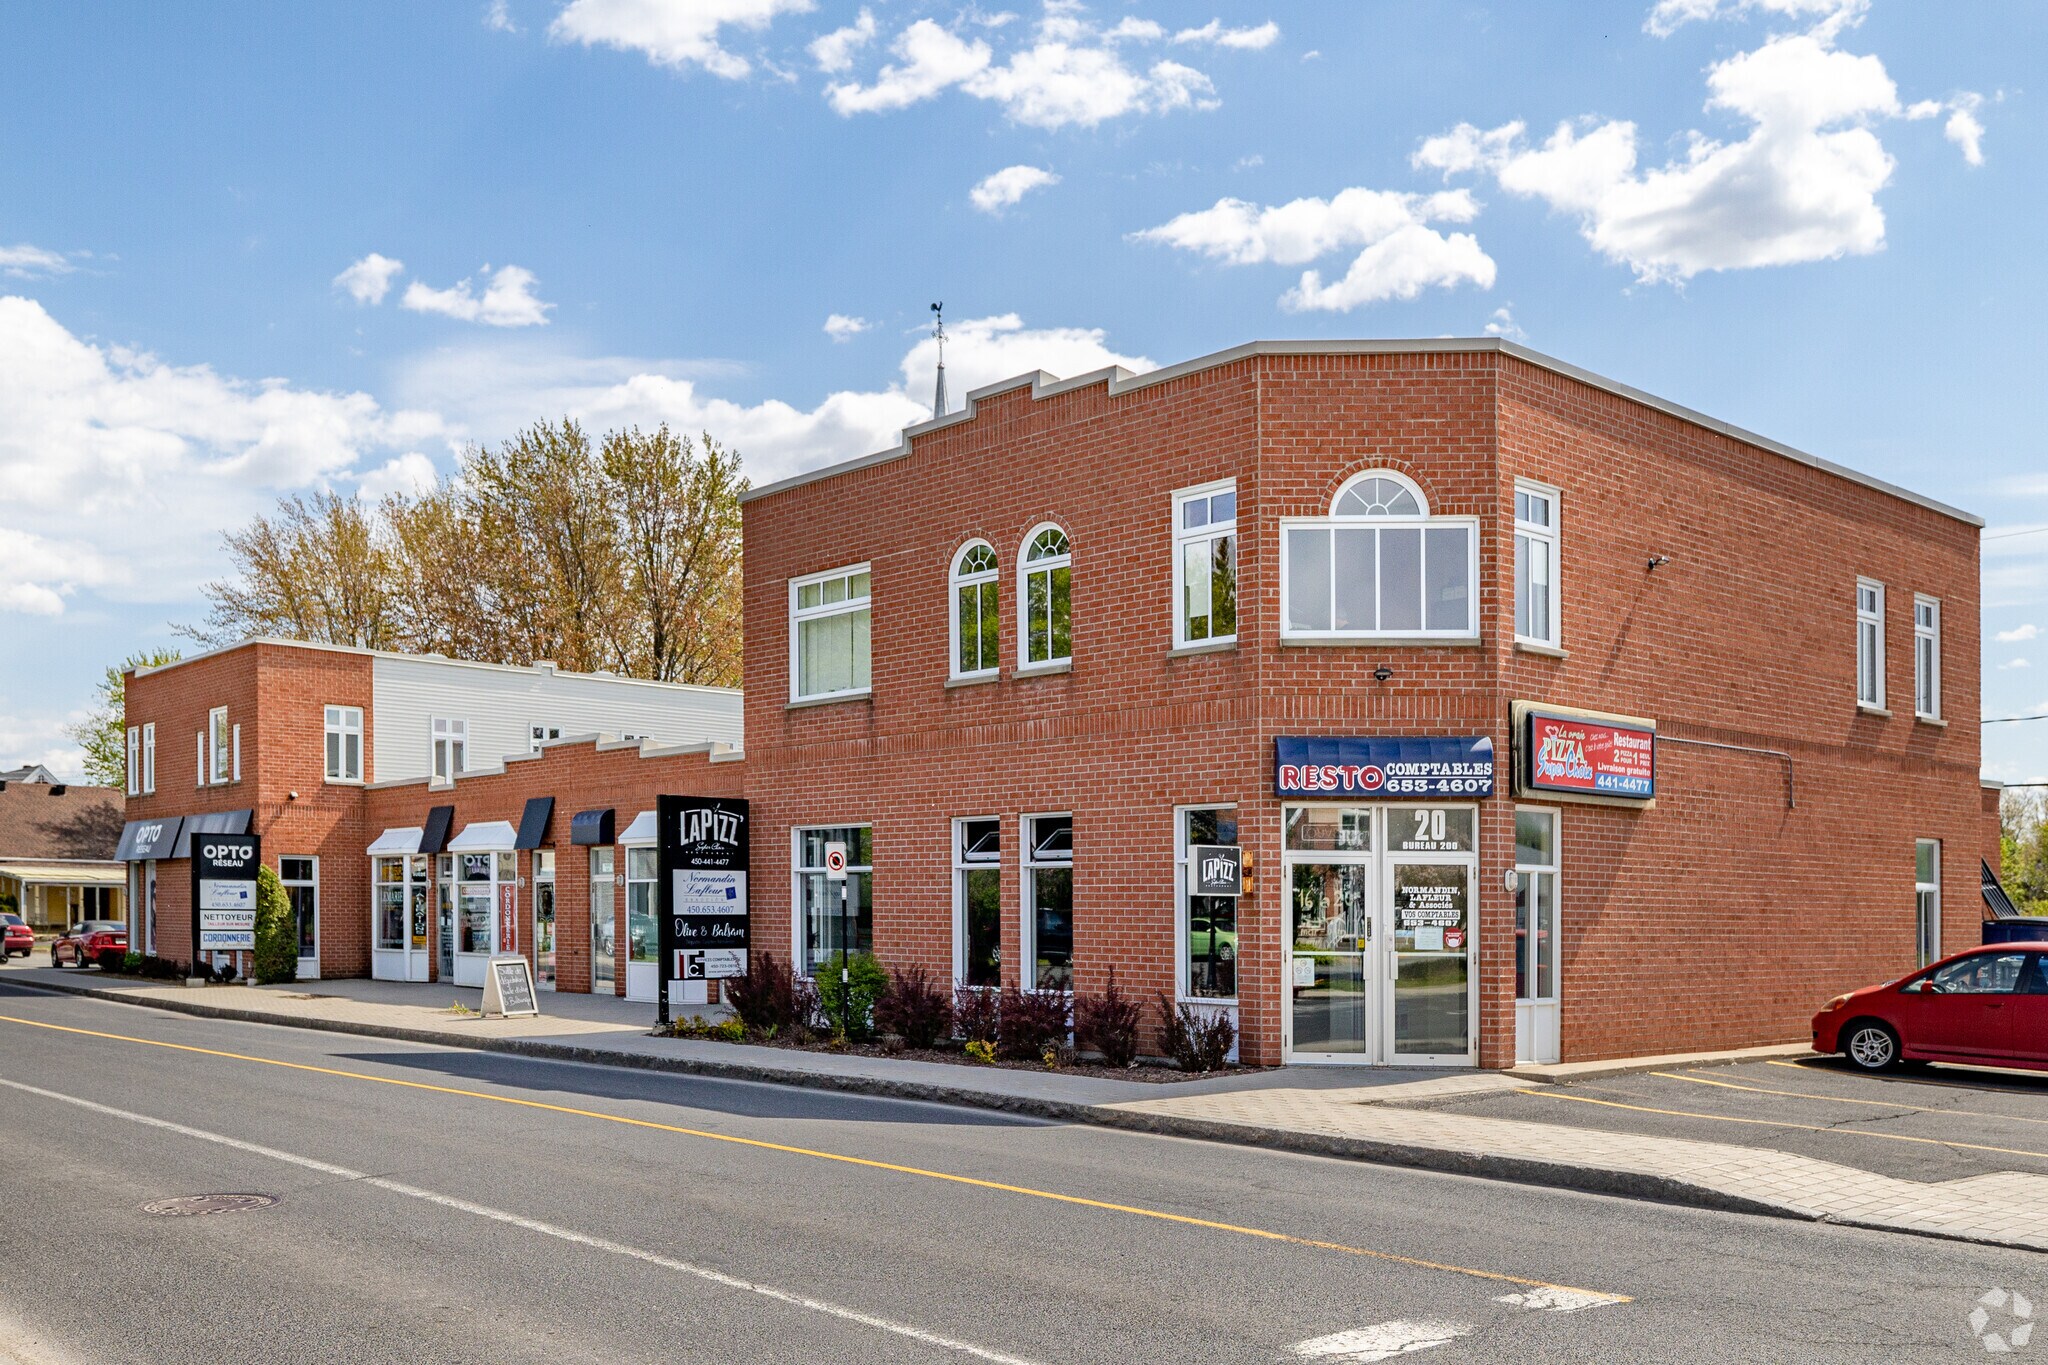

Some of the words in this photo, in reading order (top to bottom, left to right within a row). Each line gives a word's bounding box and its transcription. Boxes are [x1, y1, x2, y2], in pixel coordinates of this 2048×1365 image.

[1613, 731, 1651, 751] Restaurant
[1543, 737, 1585, 764] PIZZA
[1613, 749, 1620, 763] 2
[1620, 749, 1632, 757] PIZZA
[1537, 745, 1566, 781] Super
[1620, 757, 1632, 765] POUR
[1632, 751, 1638, 765] 1
[1386, 762, 1493, 776] COMPTABLES
[1597, 762, 1626, 774] Livraison
[1279, 764, 1384, 791] RESTO
[1597, 775, 1650, 792] 441-4477
[1386, 778, 1493, 793] 653-4607
[1414, 809, 1446, 841] 20
[135, 824, 162, 844] OPTO
[203, 845, 253, 859] OPTO
[1402, 842, 1437, 850] BUREAU
[1439, 842, 1458, 850] 200
[212, 858, 244, 867] RÉSEAU
[691, 857, 730, 866] 450-441-4477
[683, 872, 736, 883] Normandin
[686, 883, 723, 897] Lafleur
[1401, 886, 1461, 896] NORMANDIN,
[686, 905, 735, 914] 450.653.4607
[1408, 901, 1416, 909] &
[1418, 901, 1454, 909] Associés
[203, 913, 253, 921] NETTOYEUR
[504, 886, 512, 951] CORDONNERIE
[674, 918, 698, 937] Olive
[700, 925, 708, 937] &
[711, 922, 745, 938] Balsam
[203, 933, 251, 943] CORDONNERIE
